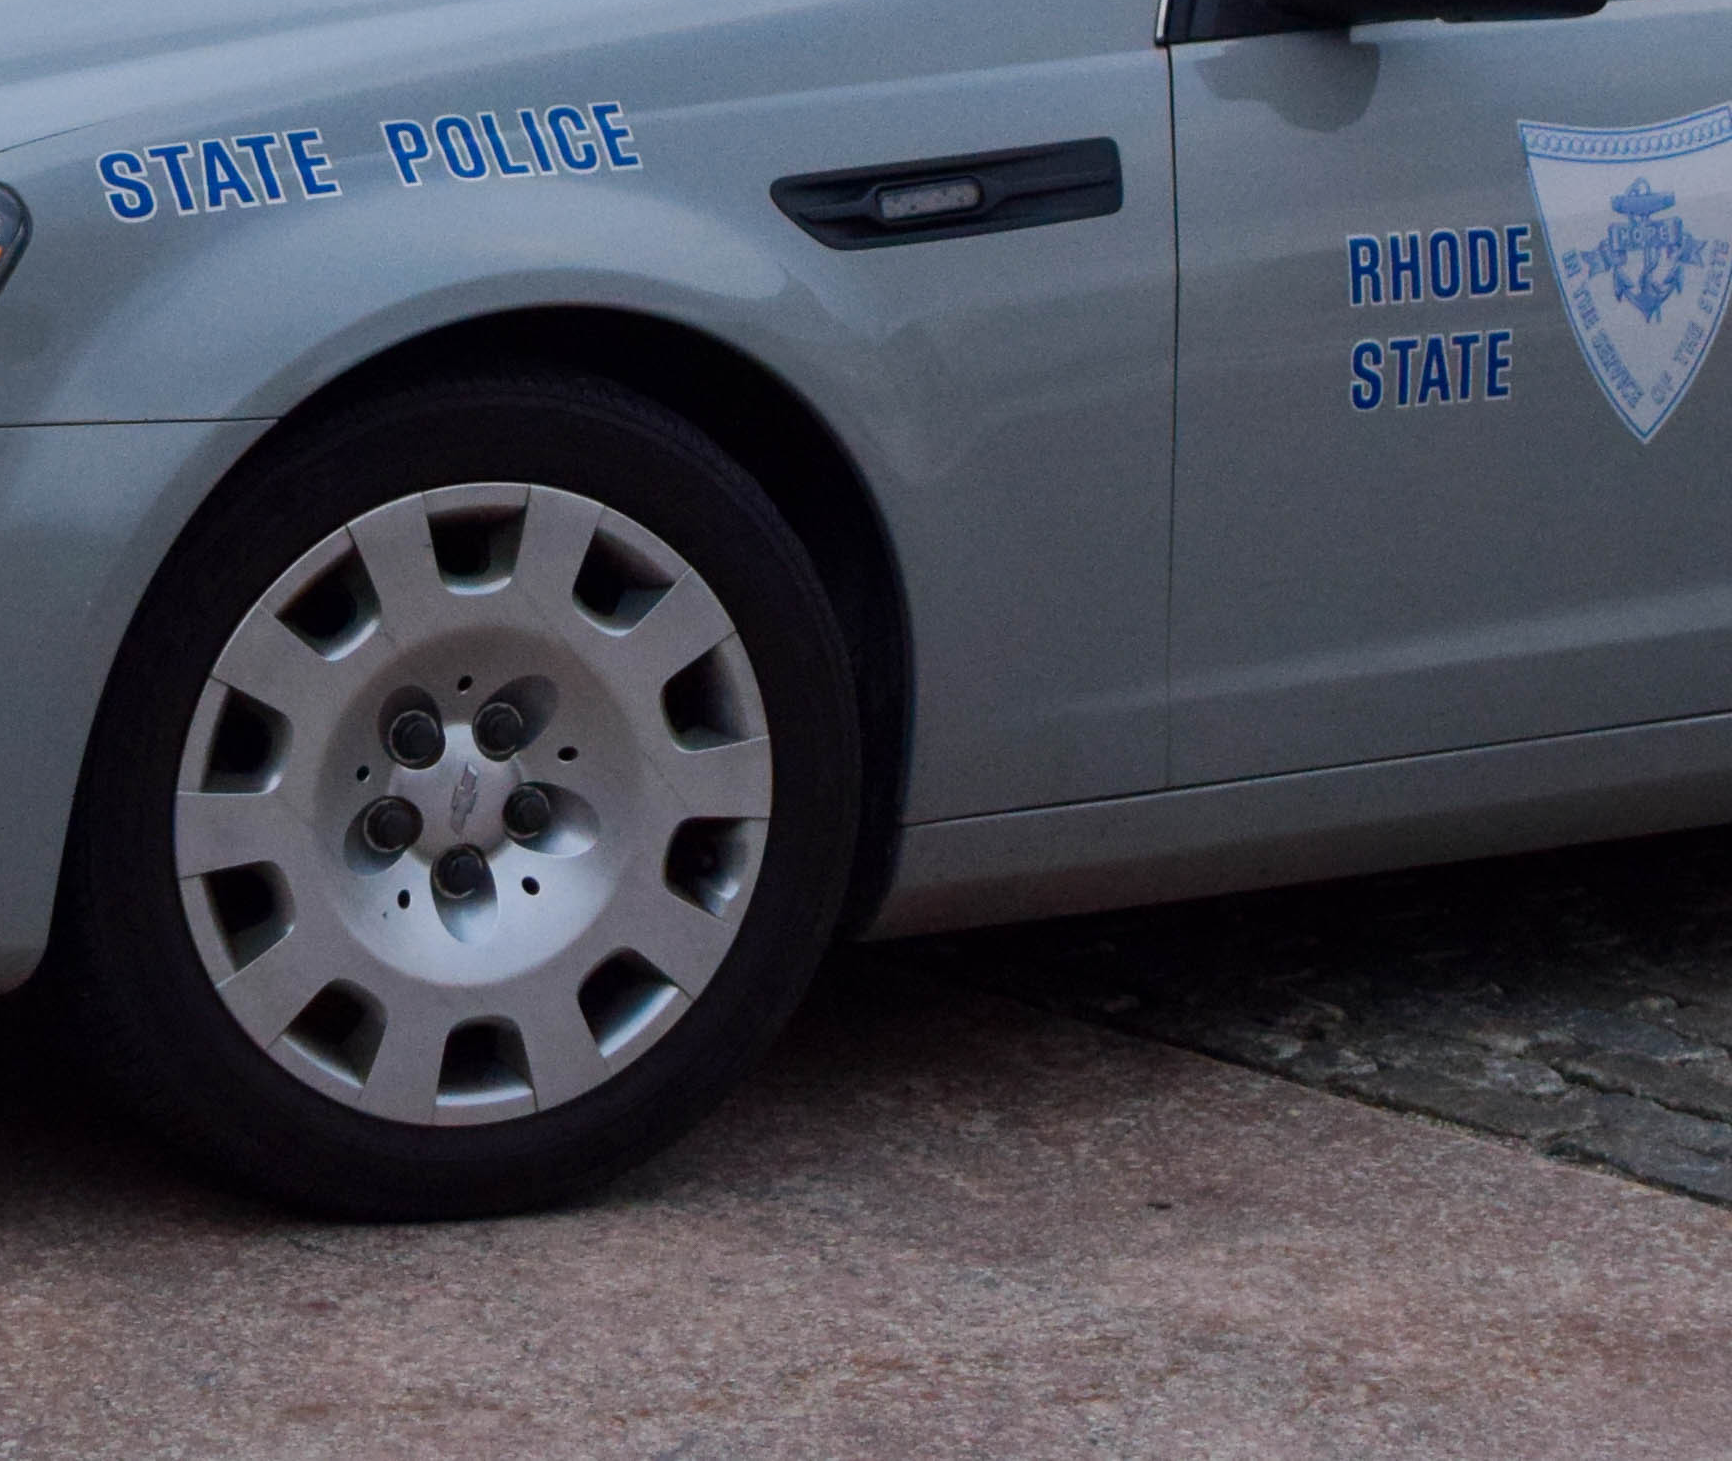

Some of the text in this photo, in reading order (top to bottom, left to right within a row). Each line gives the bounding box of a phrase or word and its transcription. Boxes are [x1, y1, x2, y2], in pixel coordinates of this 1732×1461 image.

[96, 101, 643, 222] STATE POLICE
[1347, 224, 1534, 307] RHODE
[1350, 329, 1513, 411] STATE
